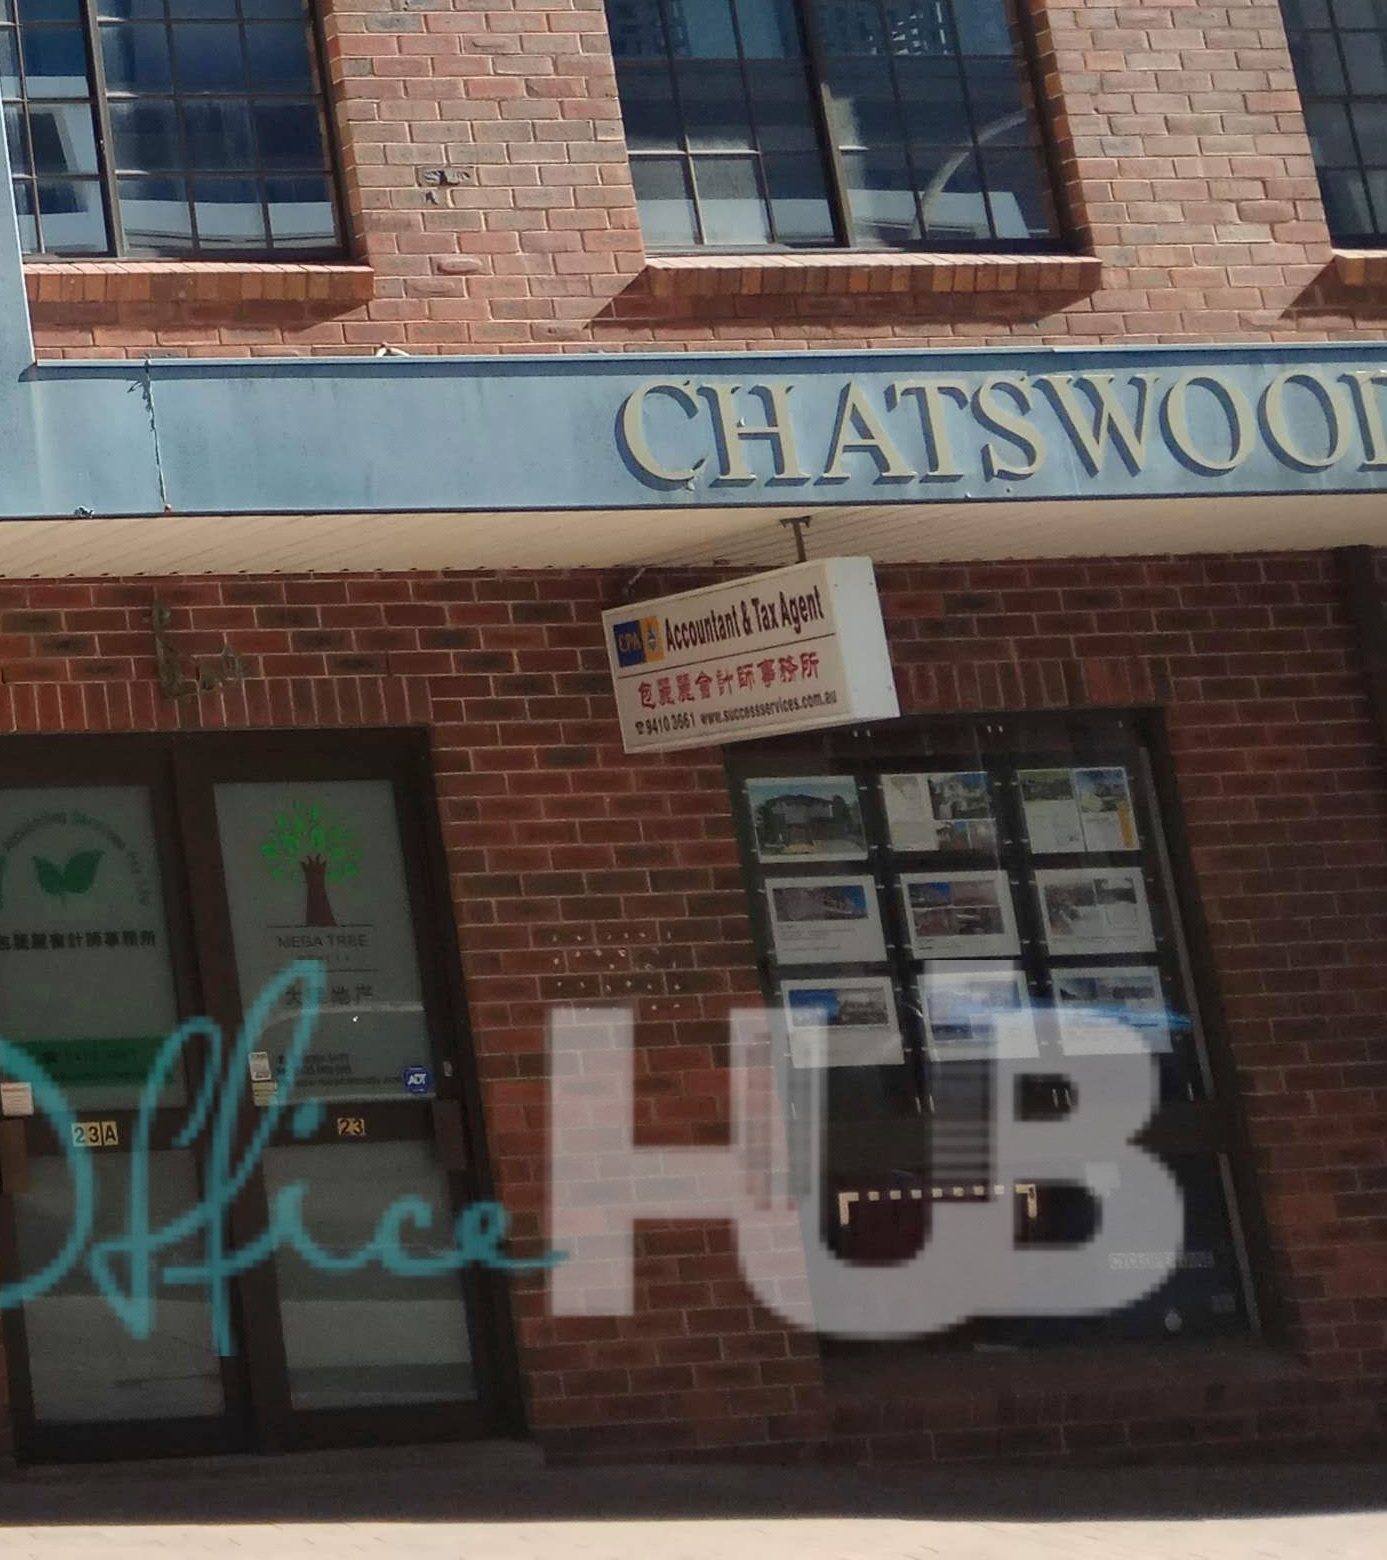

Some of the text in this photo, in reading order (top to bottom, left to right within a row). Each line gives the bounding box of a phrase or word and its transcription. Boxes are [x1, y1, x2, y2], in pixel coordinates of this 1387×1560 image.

[664, 585, 824, 652] Accountant & Tax Agent
[74, 1125, 117, 1143] 23A
[339, 1118, 364, 1136] 23
